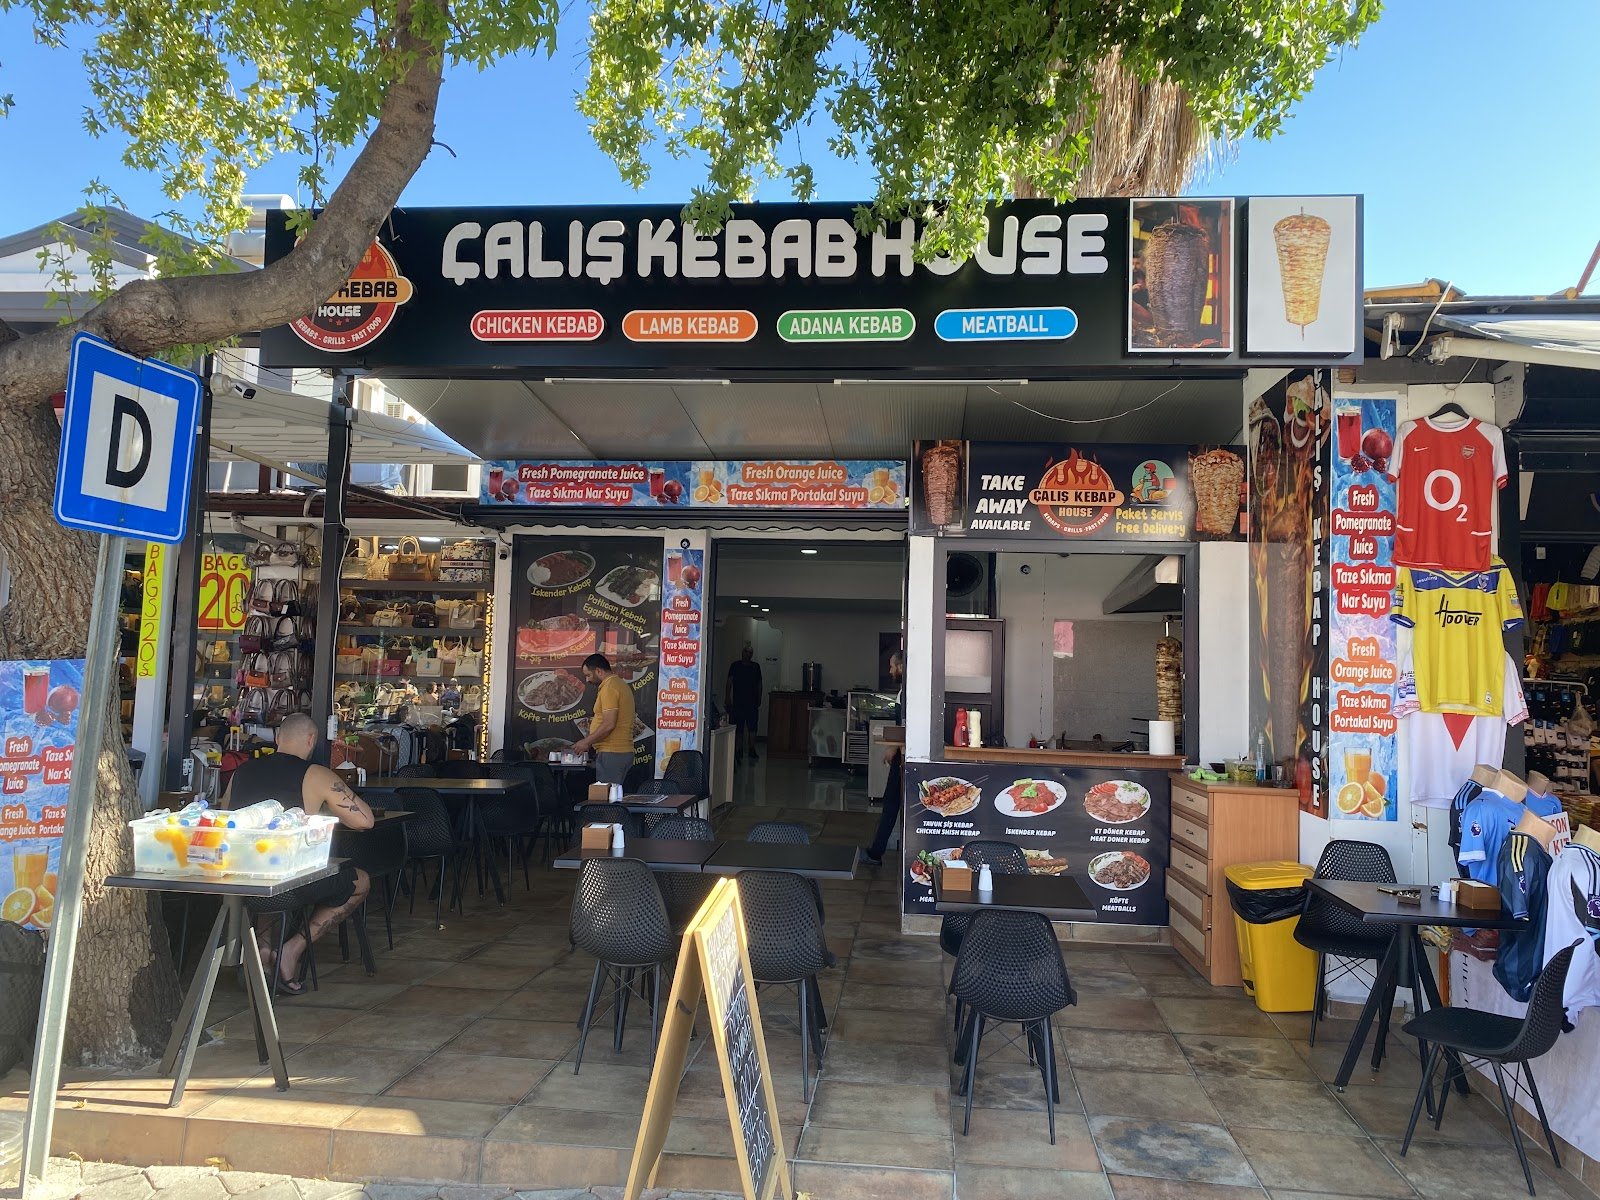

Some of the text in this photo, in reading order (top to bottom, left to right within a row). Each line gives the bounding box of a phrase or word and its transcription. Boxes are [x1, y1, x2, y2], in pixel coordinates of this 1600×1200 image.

[442, 219, 625, 286] ÇALIŞ
[637, 218, 857, 278] KEBAB
[318, 305, 361, 317] HOUSE
[296, 319, 319, 340] KEBABS
[322, 336, 346, 345] GRILLS
[351, 328, 368, 342] FAST
[367, 316, 382, 334] FOOD
[477, 316, 598, 334] CHICKEN KEBAB
[640, 316, 739, 335] LAMB KEBAB
[790, 316, 902, 335] ADANA KEBAB
[962, 315, 1048, 334] MEATBALL
[105, 394, 152, 488] D
[521, 466, 645, 482] Fresh Pomegranate Juice
[746, 466, 843, 482] Fresh Orange Juice
[981, 475, 1026, 491] TAKE
[529, 487, 629, 502] Taze Sıkma Nar Suyu
[731, 488, 864, 504] Taze Sıkma Portakal Suyu
[1033, 491, 1116, 503] ÇALIŞ KEBAP
[1352, 490, 1375, 507] Fresh
[975, 498, 1029, 514] AWAY
[1058, 507, 1093, 517] HOUSE
[1115, 508, 1184, 520] Paket Servis
[970, 519, 1031, 530] AVAILABLE
[1063, 526, 1083, 534] GRILLS
[1115, 521, 1186, 538] Free Delivery
[1335, 513, 1392, 535] Pomegranate
[1353, 538, 1374, 554] Juice
[203, 555, 248, 571] BAGS
[1312, 517, 1323, 646] KEBAP
[1336, 568, 1392, 585] Taze Sıkma
[568, 578, 592, 594] Kebap
[675, 598, 689, 608] Fresh
[1341, 592, 1360, 609] Nar
[1361, 593, 1386, 613] Suyu
[582, 603, 645, 635] Eggplant Kebab
[664, 611, 699, 623] Pomegranate
[674, 624, 687, 634] Juice
[664, 640, 678, 650] Taze
[1352, 642, 1376, 657] Fresh
[549, 649, 569, 661] Meat
[666, 655, 694, 665] Nar Suyu
[1335, 663, 1393, 682] Orange Juice
[632, 671, 655, 691] Kebap
[671, 680, 686, 689] Fresh
[661, 691, 696, 702] Orange Juice
[1341, 695, 1360, 708] Taze
[1360, 695, 1387, 709] Sıkma
[518, 709, 541, 722] Köfte
[548, 708, 587, 723] Meatballs
[664, 708, 676, 717] Taze
[659, 719, 695, 730] Portakal Suyu
[1334, 715, 1394, 732] Portakal Suyu
[9, 740, 29, 753] Fresh
[1312, 677, 1321, 807] HOUSE
[45, 749, 64, 762] Taze
[0, 758, 40, 773] omegranate
[47, 768, 63, 780] Nar
[6, 777, 24, 791] Juice
[5, 807, 24, 819] Fresh
[44, 809, 60, 820] Taze
[0, 824, 36, 838] ange Juice
[923, 820, 943, 828] TAVUK
[953, 821, 974, 829] KEBAP
[1125, 829, 1146, 837] KEBAP
[1109, 896, 1130, 904] KÖFTE
[1101, 904, 1137, 912] MEATBALLS
